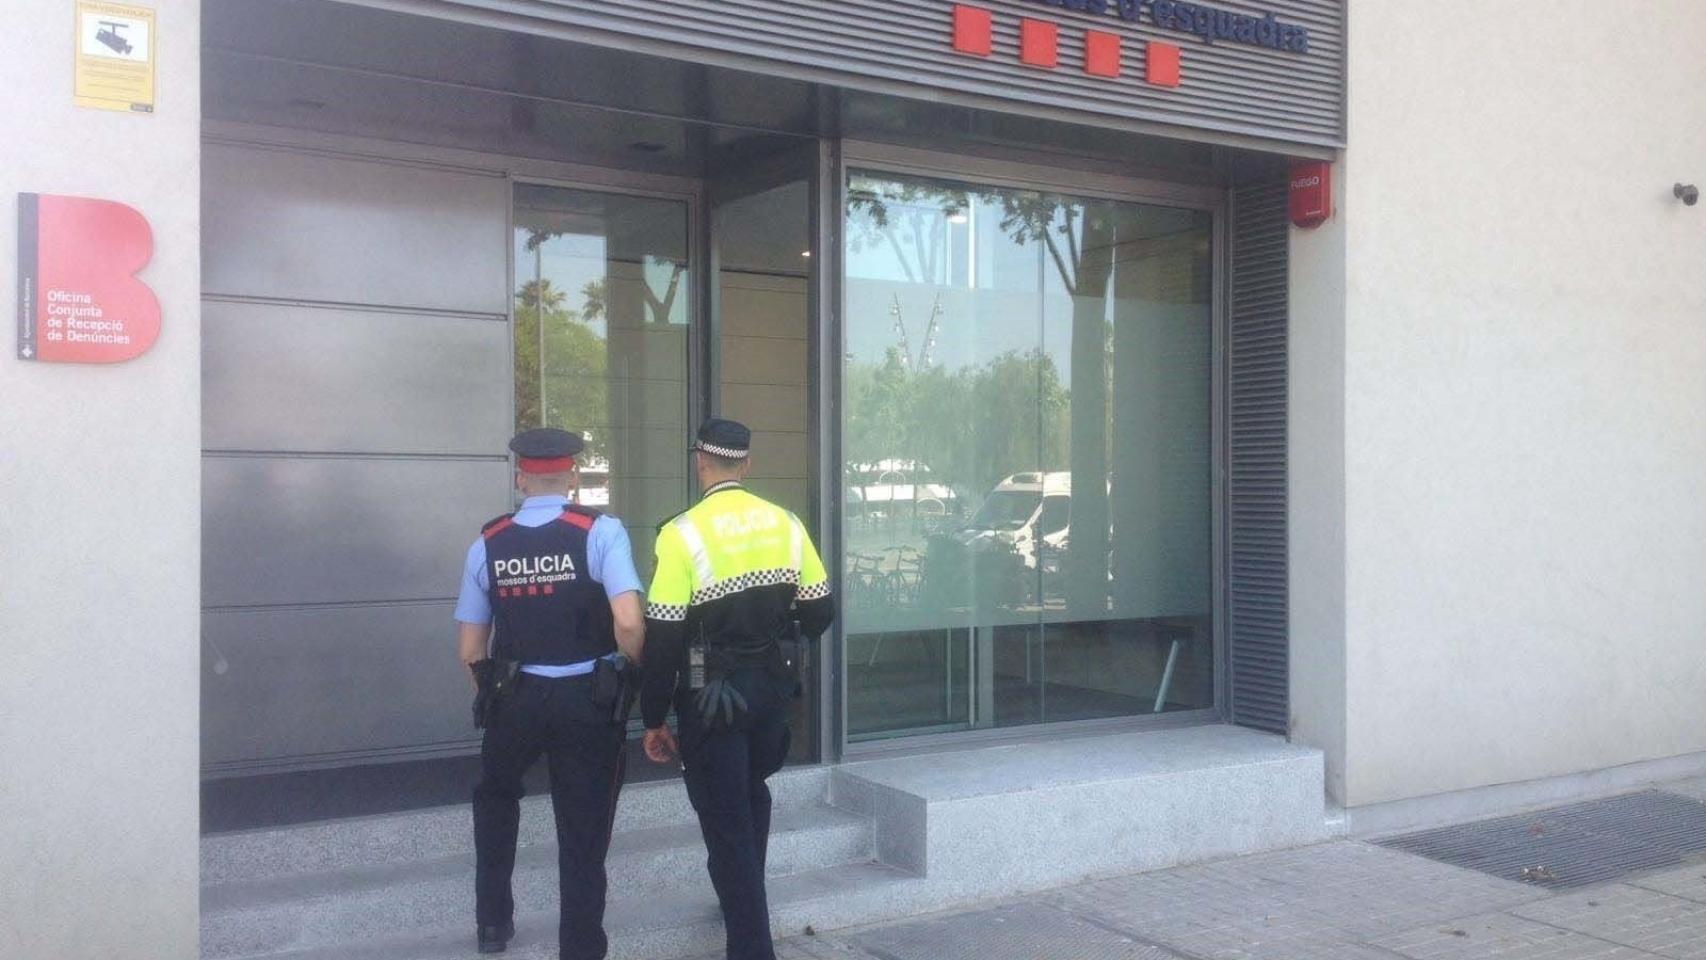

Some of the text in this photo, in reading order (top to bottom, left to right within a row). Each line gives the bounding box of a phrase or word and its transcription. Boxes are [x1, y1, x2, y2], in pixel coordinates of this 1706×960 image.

[1119, 0, 1308, 54] desquadra
[47, 290, 91, 304] Oficina
[47, 303, 102, 318] Conjunta
[47, 317, 124, 332] de Recepció
[47, 330, 130, 345] de Denúncies
[494, 554, 575, 577] POLICIA
[497, 577, 528, 587] mossos
